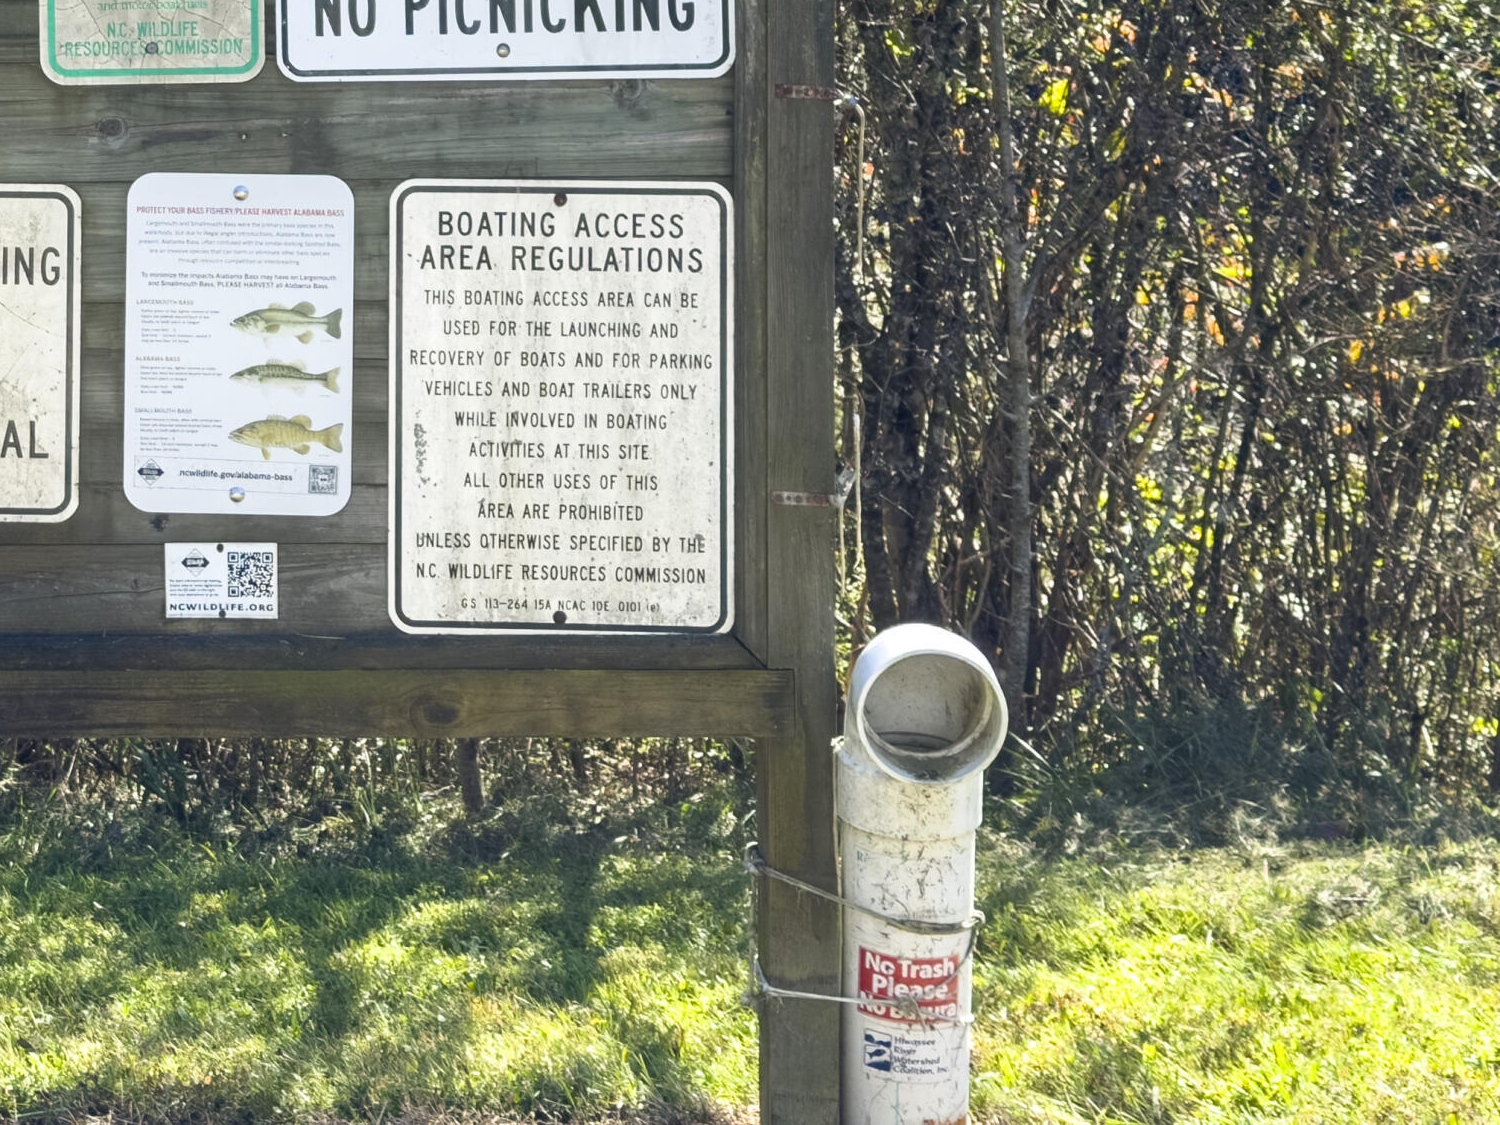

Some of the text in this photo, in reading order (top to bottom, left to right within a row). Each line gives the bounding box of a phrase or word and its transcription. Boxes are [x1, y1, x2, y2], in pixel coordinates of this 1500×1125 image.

[98, 0, 117, 11] and
[138, 21, 198, 37] WILDLIFE
[65, 39, 243, 57] RESOURCES COMMISSION
[327, 209, 344, 217] BASS
[438, 211, 684, 239] BOATING ACCESS
[420, 245, 703, 273] AREA REGULATIONS
[424, 289, 699, 309] THIS BOATING ACCESS AREA CAN BE
[443, 320, 678, 338] USED FOR THE LAUNCHING AND
[409, 349, 712, 370] RECOVERY OF BOATS AND FOR PARKING
[425, 380, 697, 400] VEHICLES AND BOAT TRAILERS ONLY
[455, 411, 667, 430] WHILE INVOLVED IN BOATING
[469, 442, 545, 458] ACTIVITIES
[554, 443, 570, 458] AT
[579, 444, 609, 459] THIS
[464, 472, 658, 490] ALL OTHER USES OF THIS
[478, 503, 643, 520] AREA ARE PROHIBITED
[416, 532, 705, 553] UNLESS OTHERWISE SPECIFIED BY THE
[448, 563, 513, 580] WILDLIFE
[521, 565, 606, 581] RESOURCES
[615, 567, 706, 584] COMMISSION
[485, 598, 528, 610] 113-264
[534, 599, 551, 610] 15A
[558, 600, 586, 610] NCAC
[865, 951, 955, 979] No Trash
[872, 974, 948, 1000] Please
[860, 990, 886, 1015] No
